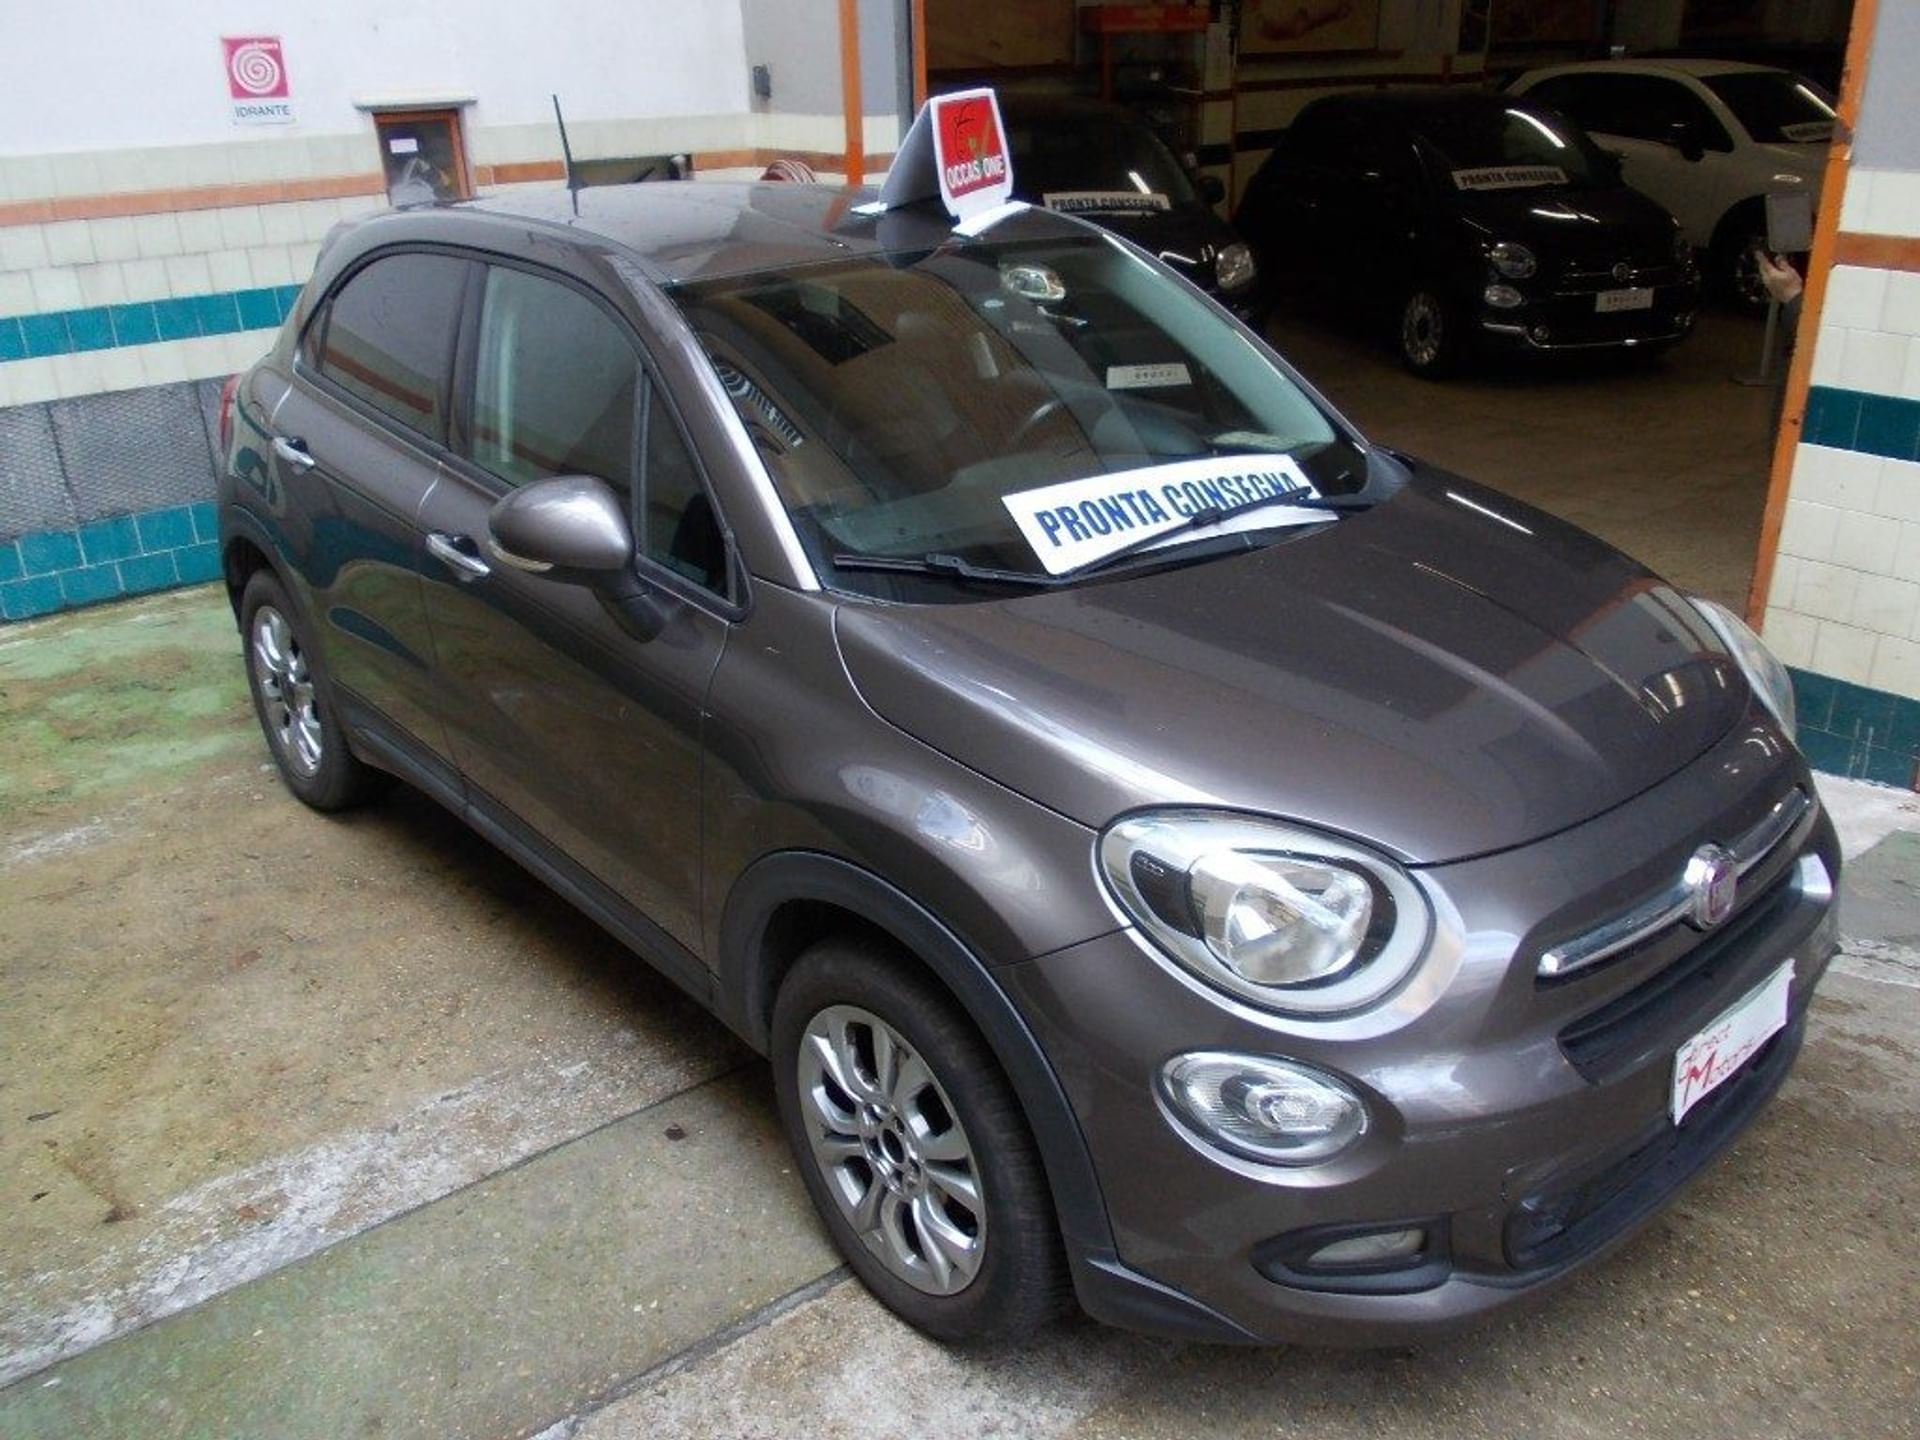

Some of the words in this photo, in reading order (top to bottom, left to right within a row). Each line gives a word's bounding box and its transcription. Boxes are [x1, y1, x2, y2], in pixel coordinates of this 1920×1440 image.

[233, 104, 291, 118] IDRANTE
[946, 155, 1006, 189] OCCASONE
[1034, 489, 1171, 547] PRONTA
[1161, 472, 1299, 519] CONSEGNA
